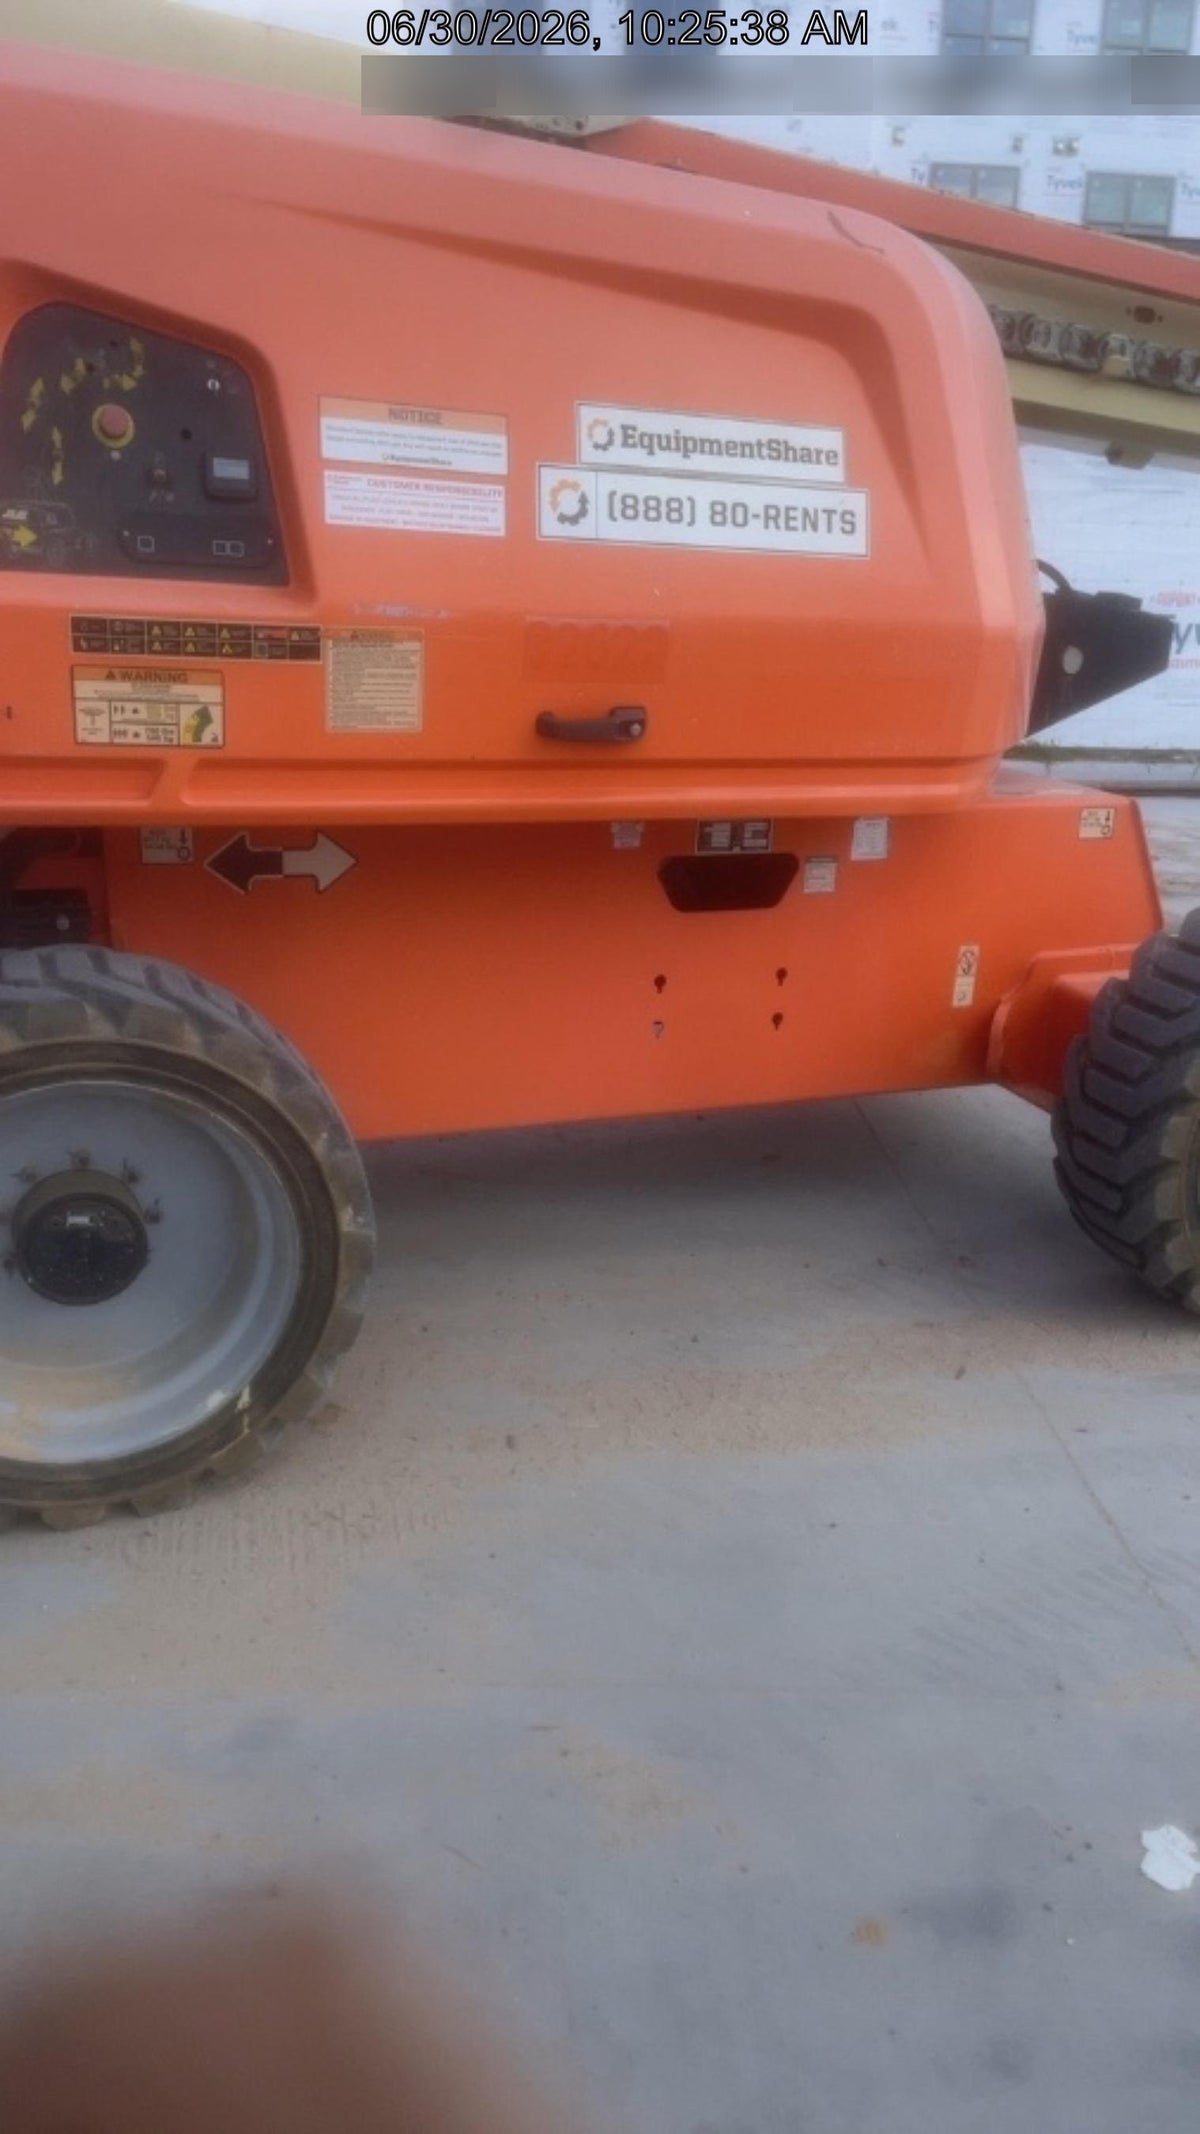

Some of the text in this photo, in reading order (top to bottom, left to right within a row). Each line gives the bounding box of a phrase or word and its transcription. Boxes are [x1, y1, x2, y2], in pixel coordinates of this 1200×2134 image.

[388, 407, 443, 425] NOTICE
[620, 424, 840, 467] EquipmentShare
[607, 490, 857, 536] (888) 80-RENTS
[120, 669, 188, 684] WARNING
